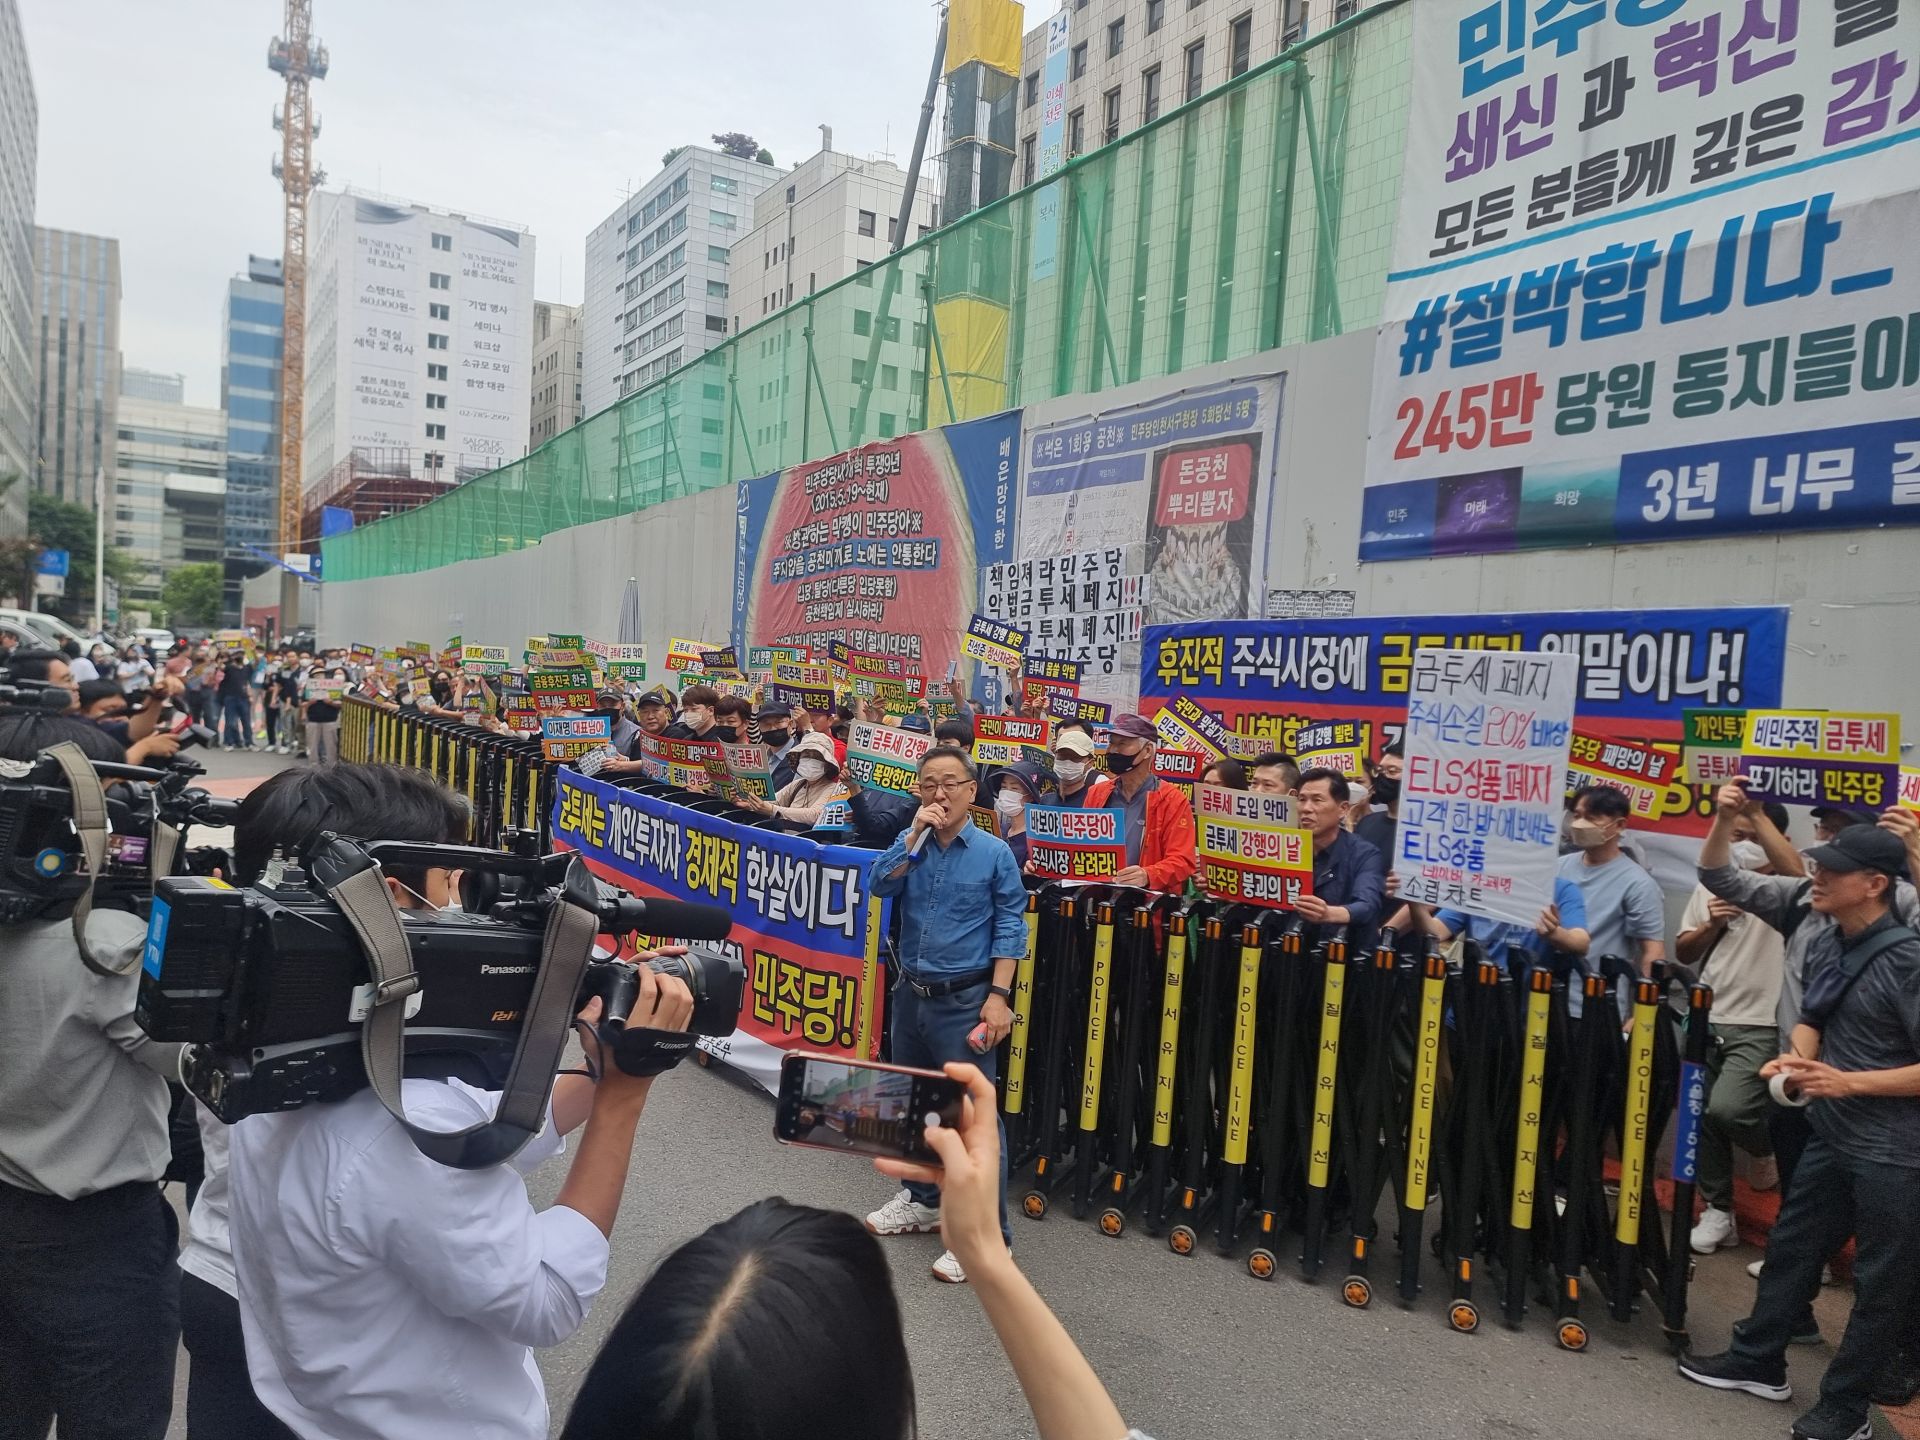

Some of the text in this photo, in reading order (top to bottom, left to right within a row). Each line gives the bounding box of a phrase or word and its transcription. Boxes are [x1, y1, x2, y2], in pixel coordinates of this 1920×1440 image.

[1049, 13, 1067, 42] 24
[1049, 38, 1067, 54] Hour
[1046, 82, 1064, 107] 인쇄
[1445, 72, 1559, 184] 쇄신
[1578, 55, 1636, 132] 과
[1654, 0, 1803, 98] 혁신
[1045, 102, 1062, 126] 전문
[1429, 49, 1920, 259] 모든 분들께 깊은 감
[468, 300, 508, 315] 기업 행사
[474, 321, 501, 334] 세미나
[353, 337, 376, 349] 세탁
[473, 340, 501, 353] 워크샵
[462, 358, 510, 374] 소규모 모임
[1393, 372, 1544, 461] 245만
[1554, 360, 1657, 437] 당원
[1068, 431, 1092, 456] 1회용
[865, 450, 901, 478] 투쟁9년
[1178, 452, 1229, 486] 돈공천
[1553, 489, 1582, 507] 희망
[1641, 462, 1720, 523] 3년
[1749, 447, 1855, 517] 너무
[1167, 487, 1234, 521] 뿌리뽑자
[1387, 508, 1409, 524] 민주
[1464, 499, 1488, 519] 미래
[856, 542, 887, 567] 노예는
[891, 541, 937, 567] 안통한다
[804, 599, 884, 624] 공천책임제 실시하라!
[973, 618, 993, 638] 금투세
[992, 623, 1009, 642] 강행
[1007, 630, 1024, 648] 빌런
[803, 667, 830, 686] 금투세
[1061, 664, 1077, 681] 악법
[1157, 636, 1224, 687] 후진적
[1231, 635, 1370, 692] 주식시장에
[1416, 654, 1491, 697] 금투세
[1494, 659, 1554, 701] 폐지
[804, 692, 830, 711] 민주당
[1052, 697, 1106, 724] 민주당의 금투세
[1174, 695, 1203, 724] 국민과
[547, 719, 606, 736] 이재명 대표님아
[855, 725, 872, 748] 악법
[872, 729, 904, 755] 금투세
[980, 718, 1002, 737] 국민이
[1157, 716, 1187, 744] 민주당
[1315, 725, 1333, 747] 강행
[1333, 722, 1354, 745] 빌런
[1754, 716, 1888, 754] 비민주적 금투세
[737, 747, 763, 769] 금투세
[977, 743, 1008, 762] 정신차려
[1572, 734, 1667, 779] 주당 패망의 날
[1747, 764, 1817, 799] 포기하라
[1823, 770, 1885, 806] 민주당
[1202, 789, 1289, 823] 금투세 도입 악마
[1636, 788, 1655, 812] 날
[1029, 809, 1115, 841] 바보야 민주당아
[1206, 824, 1301, 863] 금투세 강행의 날
[559, 783, 860, 938] 금투세는 개인투자자 경제적 학살이다
[1031, 845, 1118, 878] 주식시장 살려라!
[1206, 864, 1301, 905] 민주당 붕괴의 날
[480, 963, 537, 975] Panasonic
[752, 952, 855, 1049] 민주당!
[653, 1041, 691, 1050] FUJINON
[1084, 961, 1105, 1109] POLICE LINE
[1154, 972, 1181, 1125] 질서유지선
[1229, 986, 1252, 1142] POLICE LINE
[1312, 1003, 1342, 1164] 질서유지선
[1413, 1020, 1437, 1187] POLICE LINE
[1516, 1034, 1548, 1206] 질서유지선
[1628, 1048, 1651, 1220] POLICE LINE
